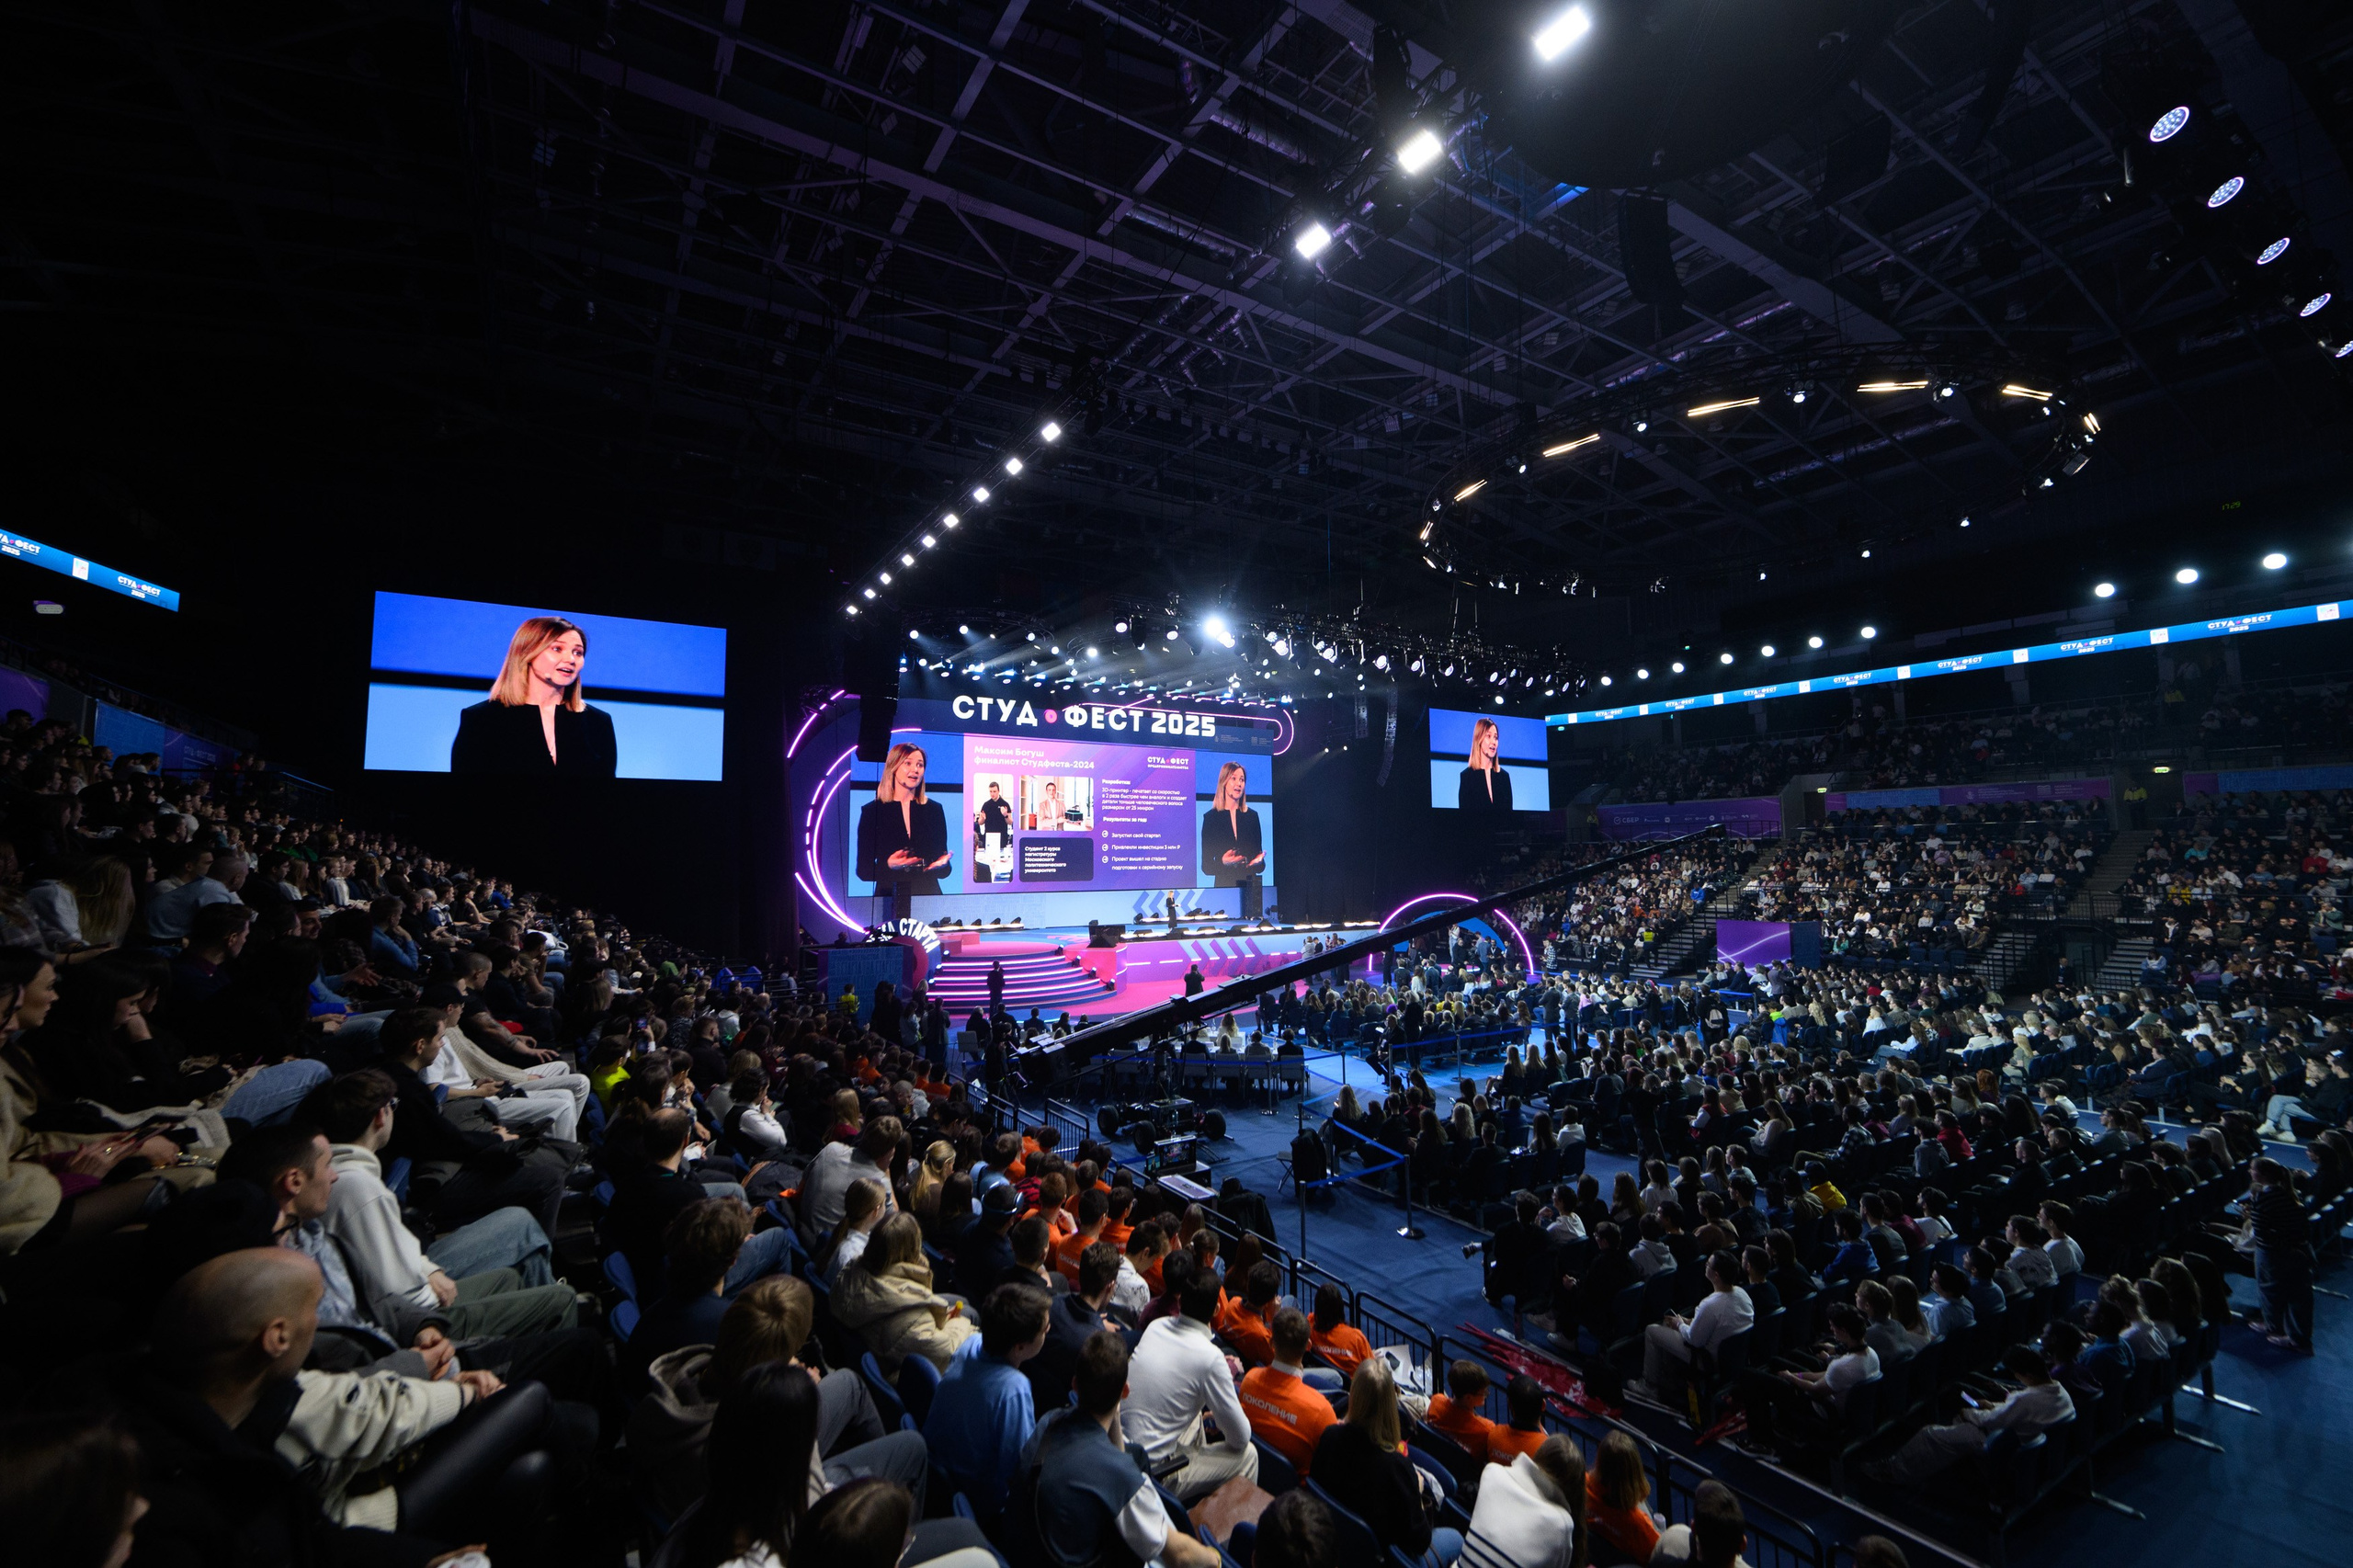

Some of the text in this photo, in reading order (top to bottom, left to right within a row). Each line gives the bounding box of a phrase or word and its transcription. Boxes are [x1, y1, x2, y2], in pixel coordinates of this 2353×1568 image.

[2, 545, 20, 556] 2025
[16, 540, 40, 554] ФЕСТ
[2242, 615, 2272, 624] ФЕСТ
[2088, 637, 2114, 646] ФЕСТ
[952, 695, 1216, 737] СТУД ФЕСТ 2025
[974, 745, 1044, 758] Максим Богуш
[974, 756, 1095, 769] финалист Студфеста-2024
[899, 917, 940, 954] СТАРТА
[1242, 1392, 1298, 1426] ПОКОЛЕНИЕ
